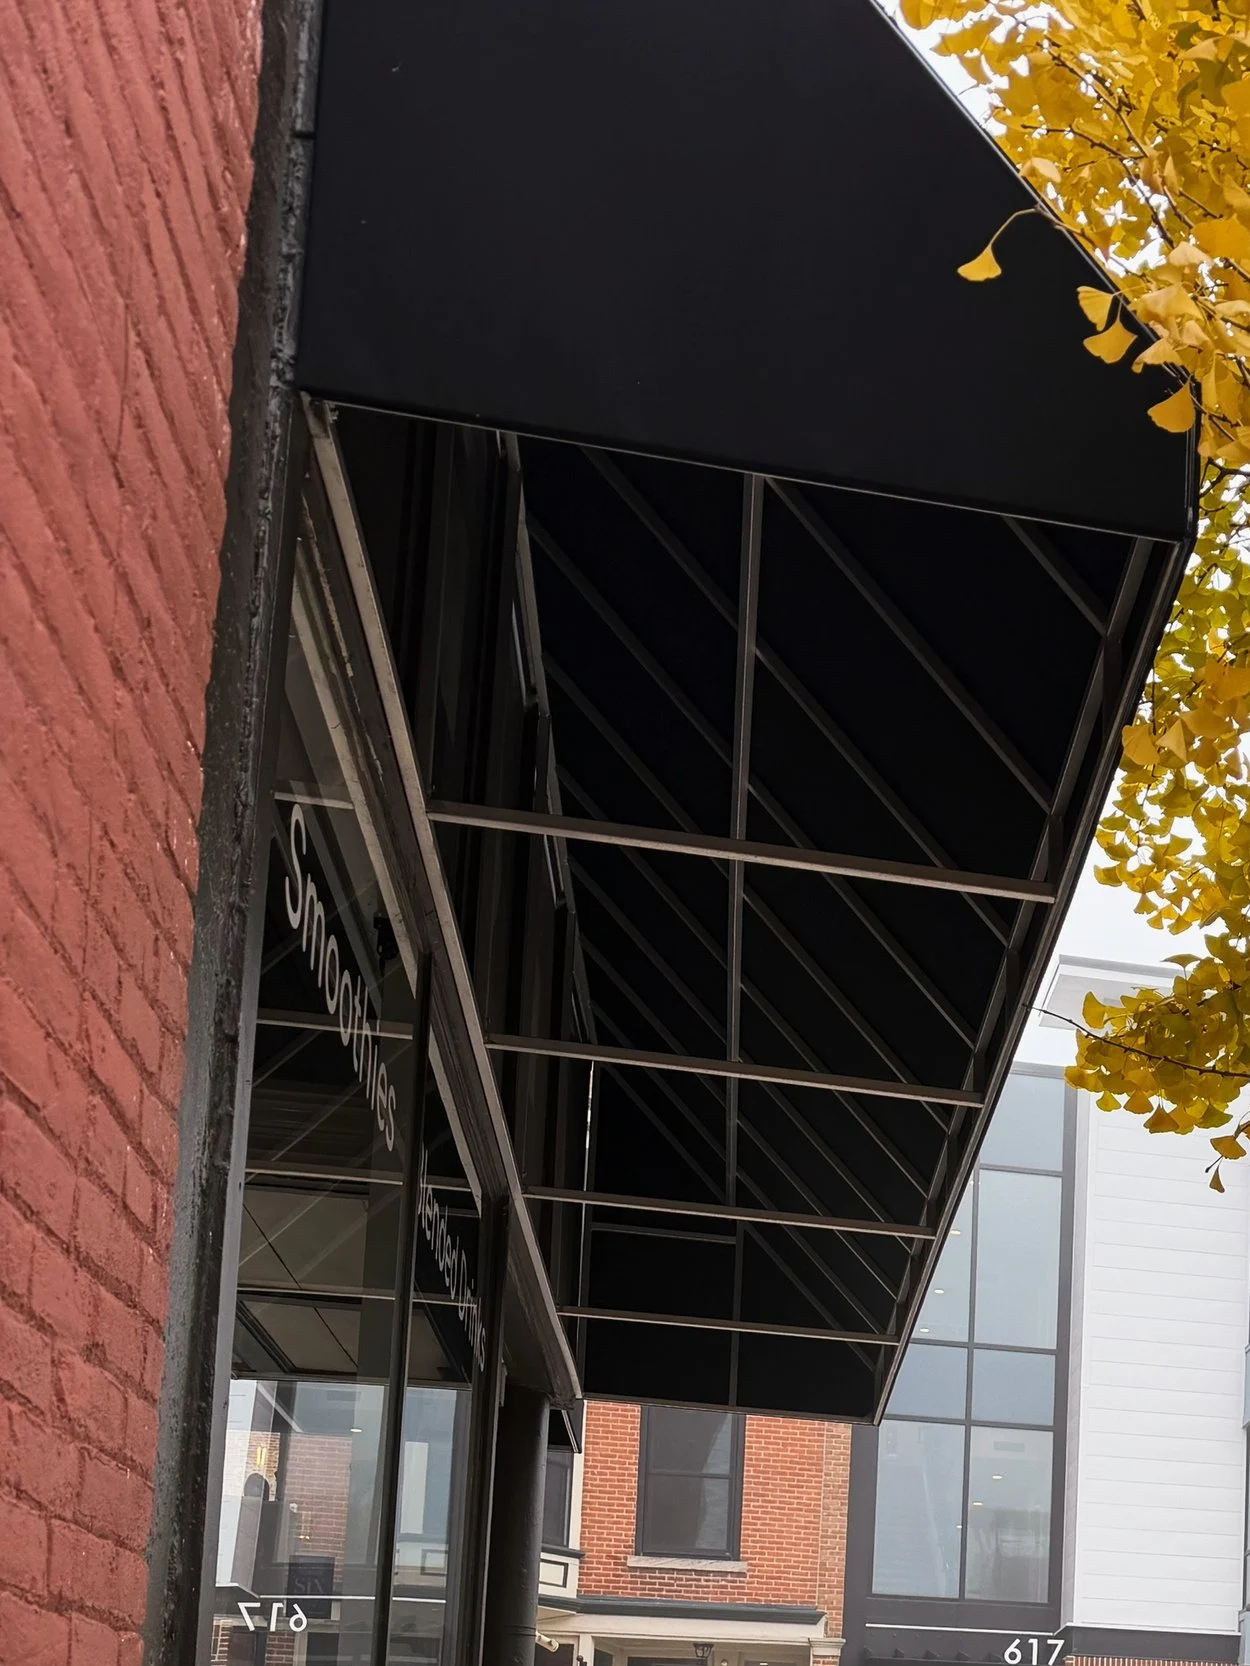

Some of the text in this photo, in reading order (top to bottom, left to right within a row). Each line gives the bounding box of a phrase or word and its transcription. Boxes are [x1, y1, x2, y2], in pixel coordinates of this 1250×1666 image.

[285, 803, 396, 1152] Smoothies
[457, 1250, 487, 1373] Drinks
[1004, 1638, 1065, 1666] 617
